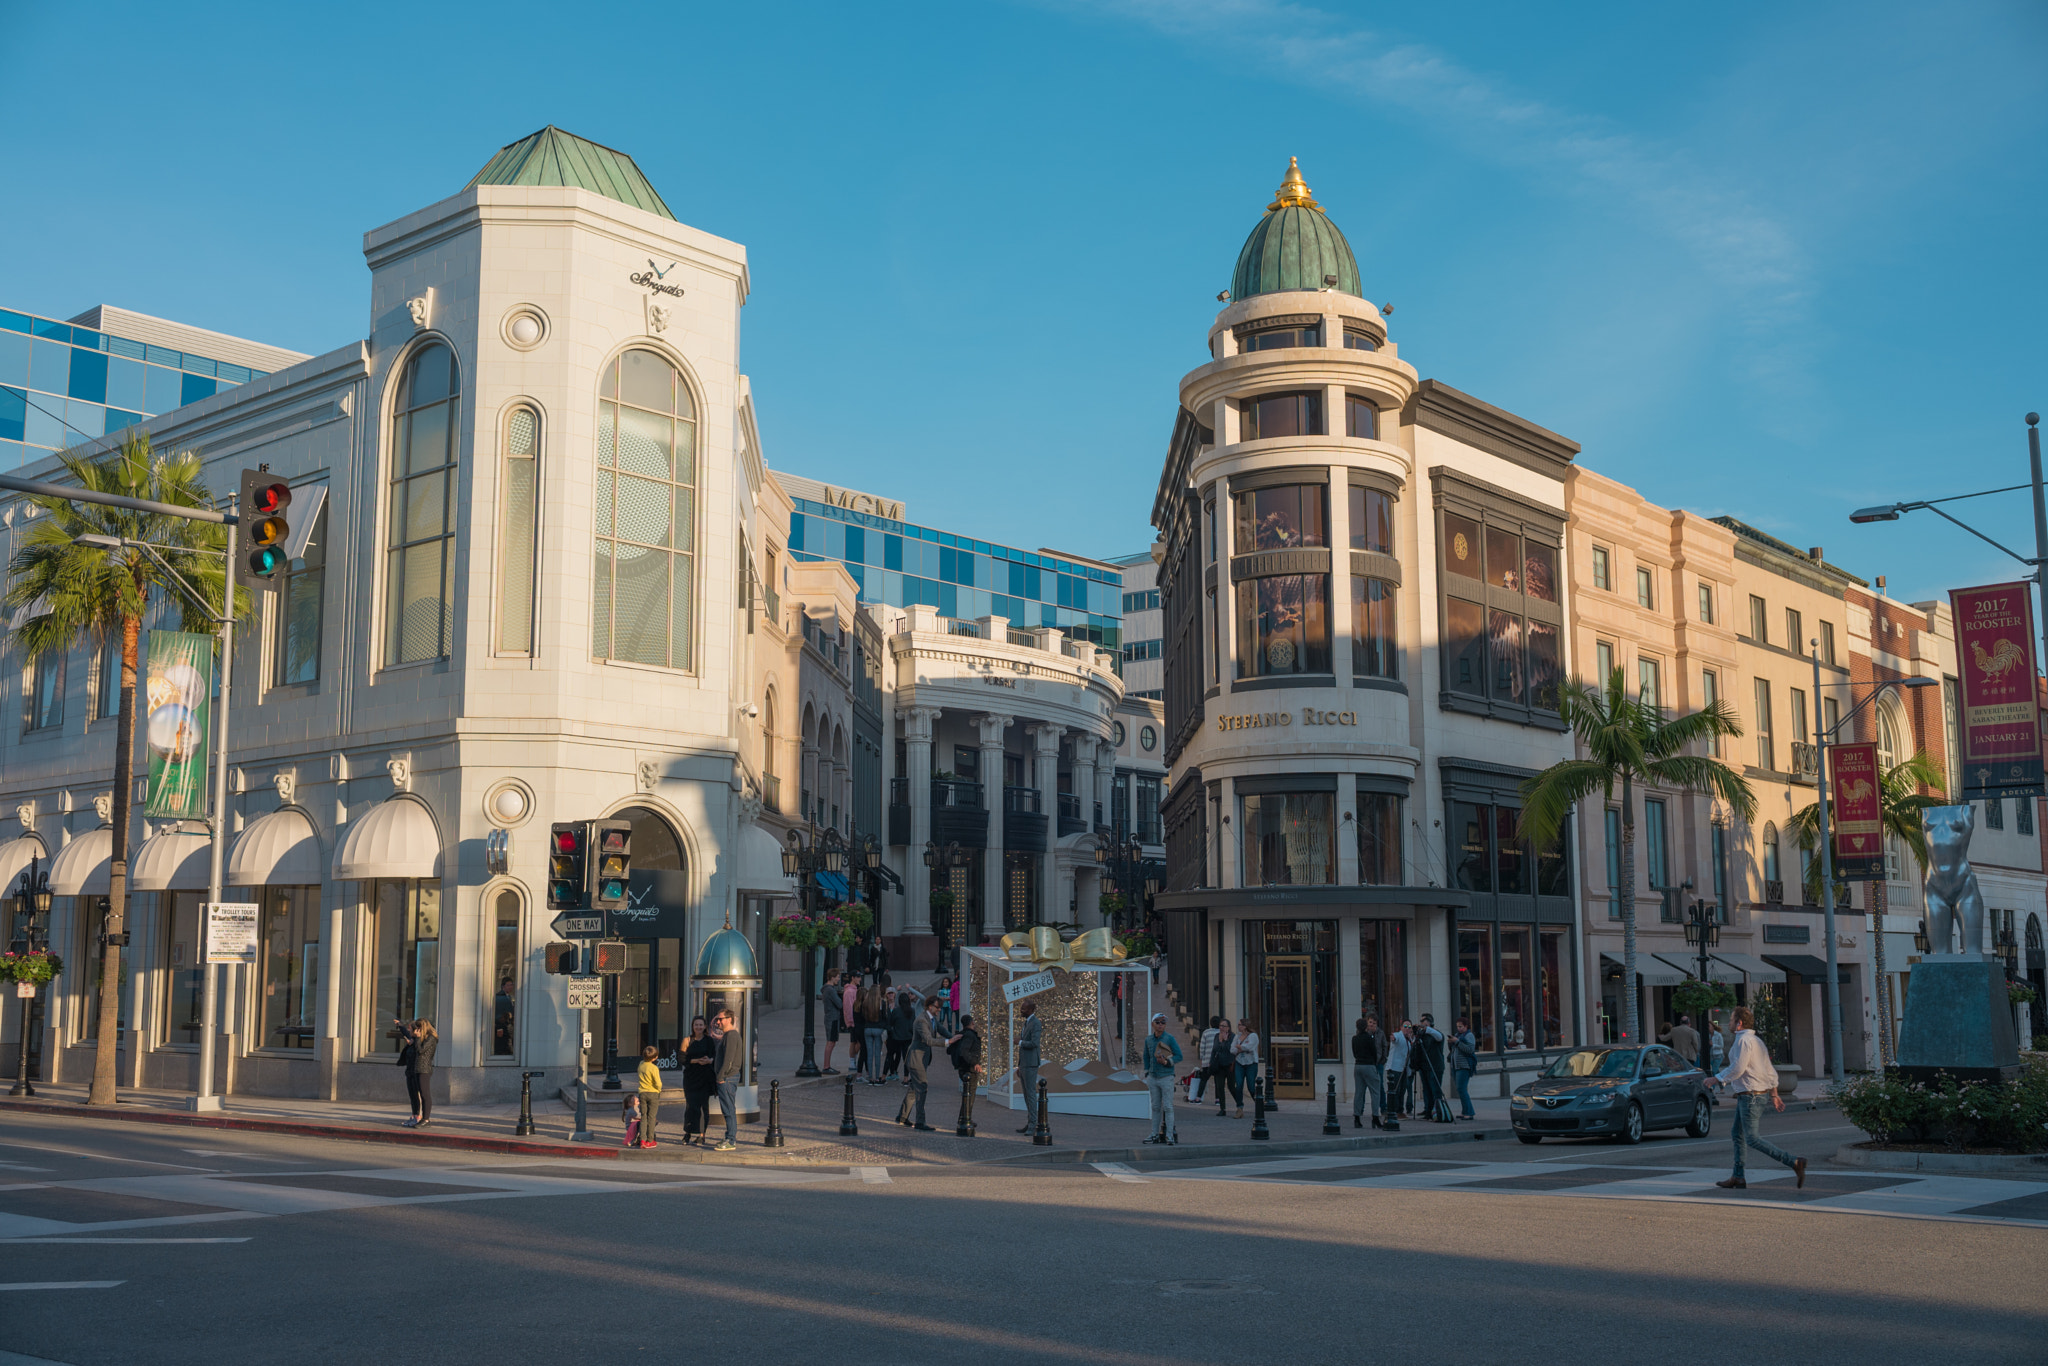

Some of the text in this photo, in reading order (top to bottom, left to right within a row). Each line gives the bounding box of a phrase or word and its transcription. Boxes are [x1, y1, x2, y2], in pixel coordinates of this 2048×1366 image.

[630, 271, 685, 297] Breguet
[824, 486, 901, 521] MGM
[1974, 598, 2008, 613] 2017
[1965, 616, 2022, 631] ROOSTER
[983, 675, 1017, 690] VERSACE
[1974, 705, 2028, 716] BEVERLY HILLS
[1217, 707, 1358, 732] STEFANO RICCI
[1998, 713, 2030, 722] THEATRE
[1975, 732, 2030, 744] JANUARY 21
[1842, 752, 1864, 761] 2017
[1837, 764, 1872, 772] ROOSTER
[2008, 788, 2035, 796] DELTA
[566, 919, 599, 930] ONE WAY
[1022, 979, 1039, 987] ONLY
[1023, 979, 1053, 993] RODEO
[569, 994, 581, 1005] OK
